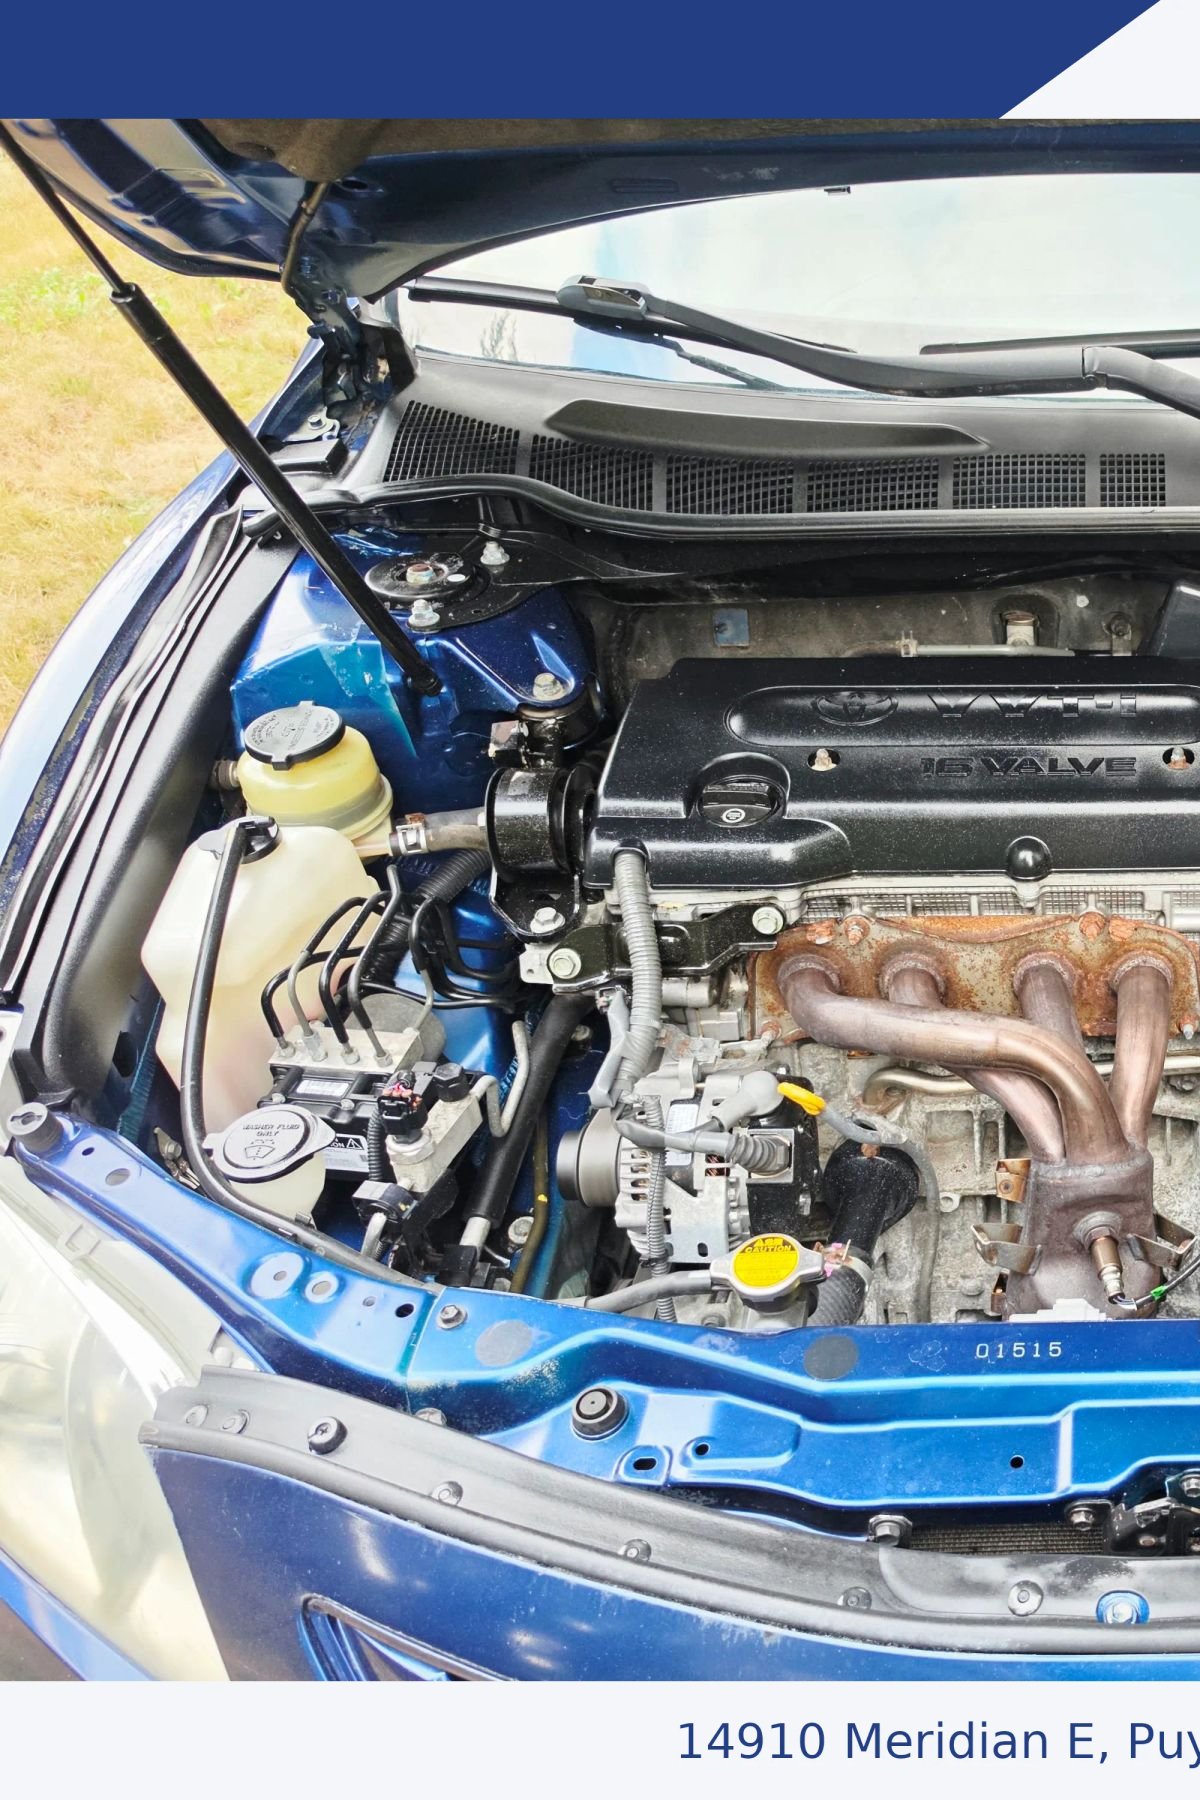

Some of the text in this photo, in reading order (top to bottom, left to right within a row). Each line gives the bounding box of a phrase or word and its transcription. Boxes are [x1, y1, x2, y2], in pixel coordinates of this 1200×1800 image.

[920, 756, 1138, 778] 16 VALVE
[276, 1121, 300, 1130] FLUID
[744, 1244, 793, 1253] CAUTION
[975, 1341, 1063, 1359] 01515
